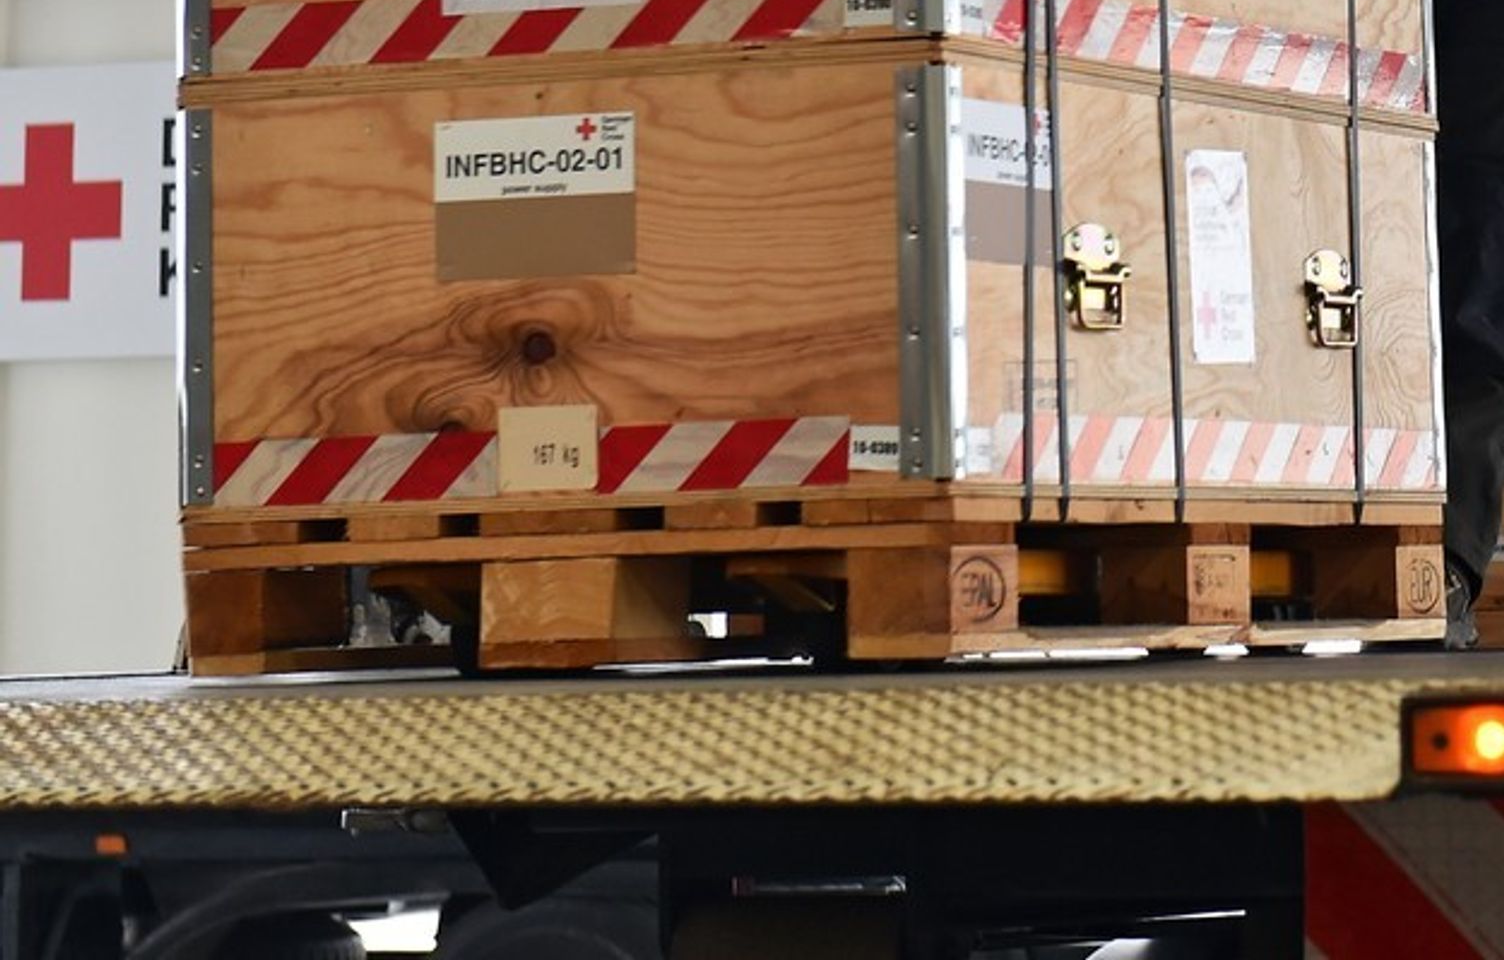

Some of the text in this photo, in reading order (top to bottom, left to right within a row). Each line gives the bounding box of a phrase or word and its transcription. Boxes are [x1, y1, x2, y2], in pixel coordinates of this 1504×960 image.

[446, 146, 623, 179] INFBHC-02-01
[533, 442, 579, 469] 167 kg
